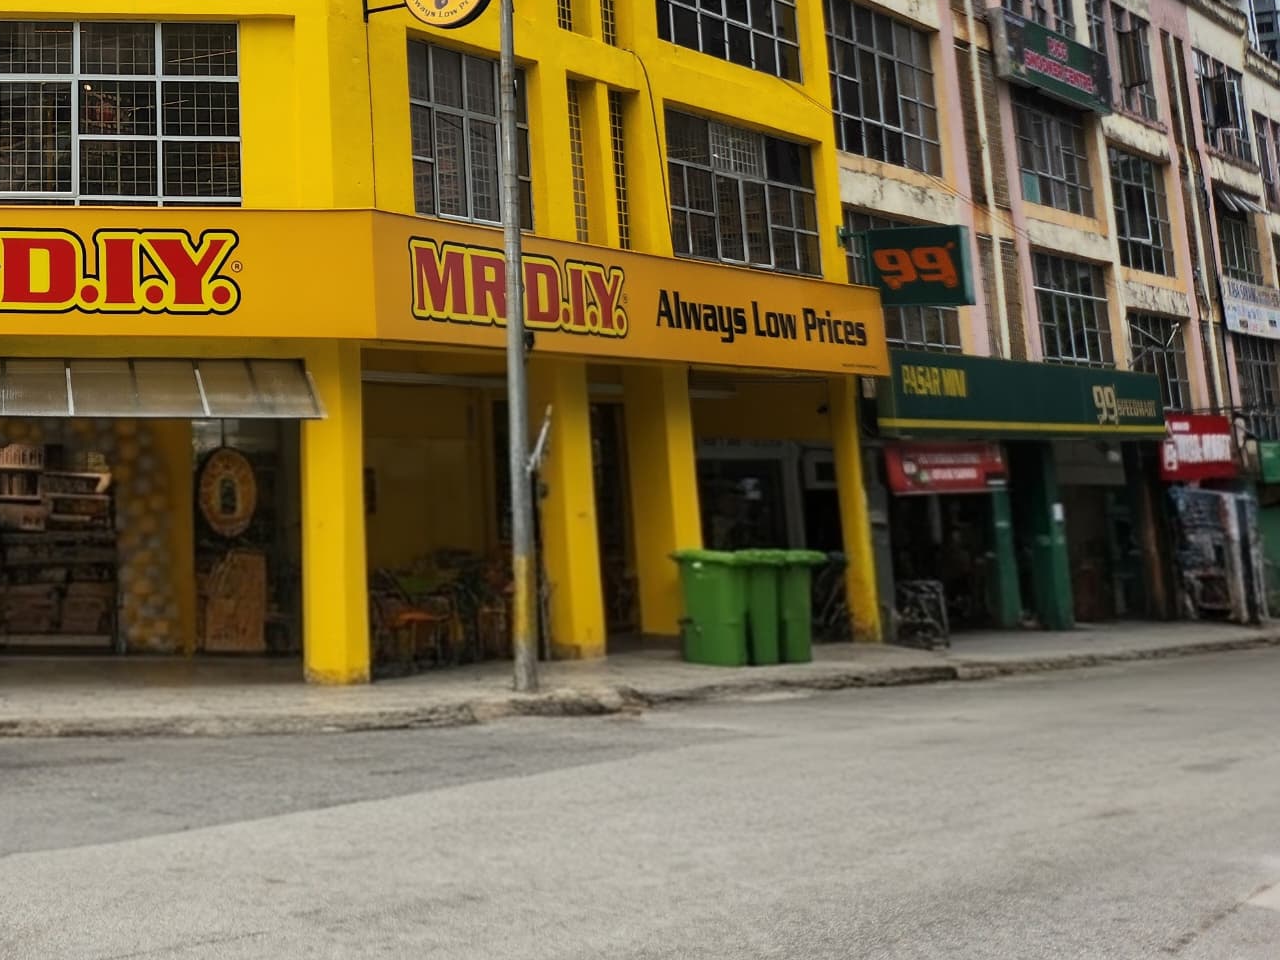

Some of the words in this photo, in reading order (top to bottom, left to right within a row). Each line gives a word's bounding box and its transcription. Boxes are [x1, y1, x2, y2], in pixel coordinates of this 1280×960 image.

[872, 245, 958, 289] 99
[656, 289, 748, 344] Always
[751, 300, 798, 340] Low
[802, 307, 868, 347] Prices
[901, 365, 942, 397] PASAR
